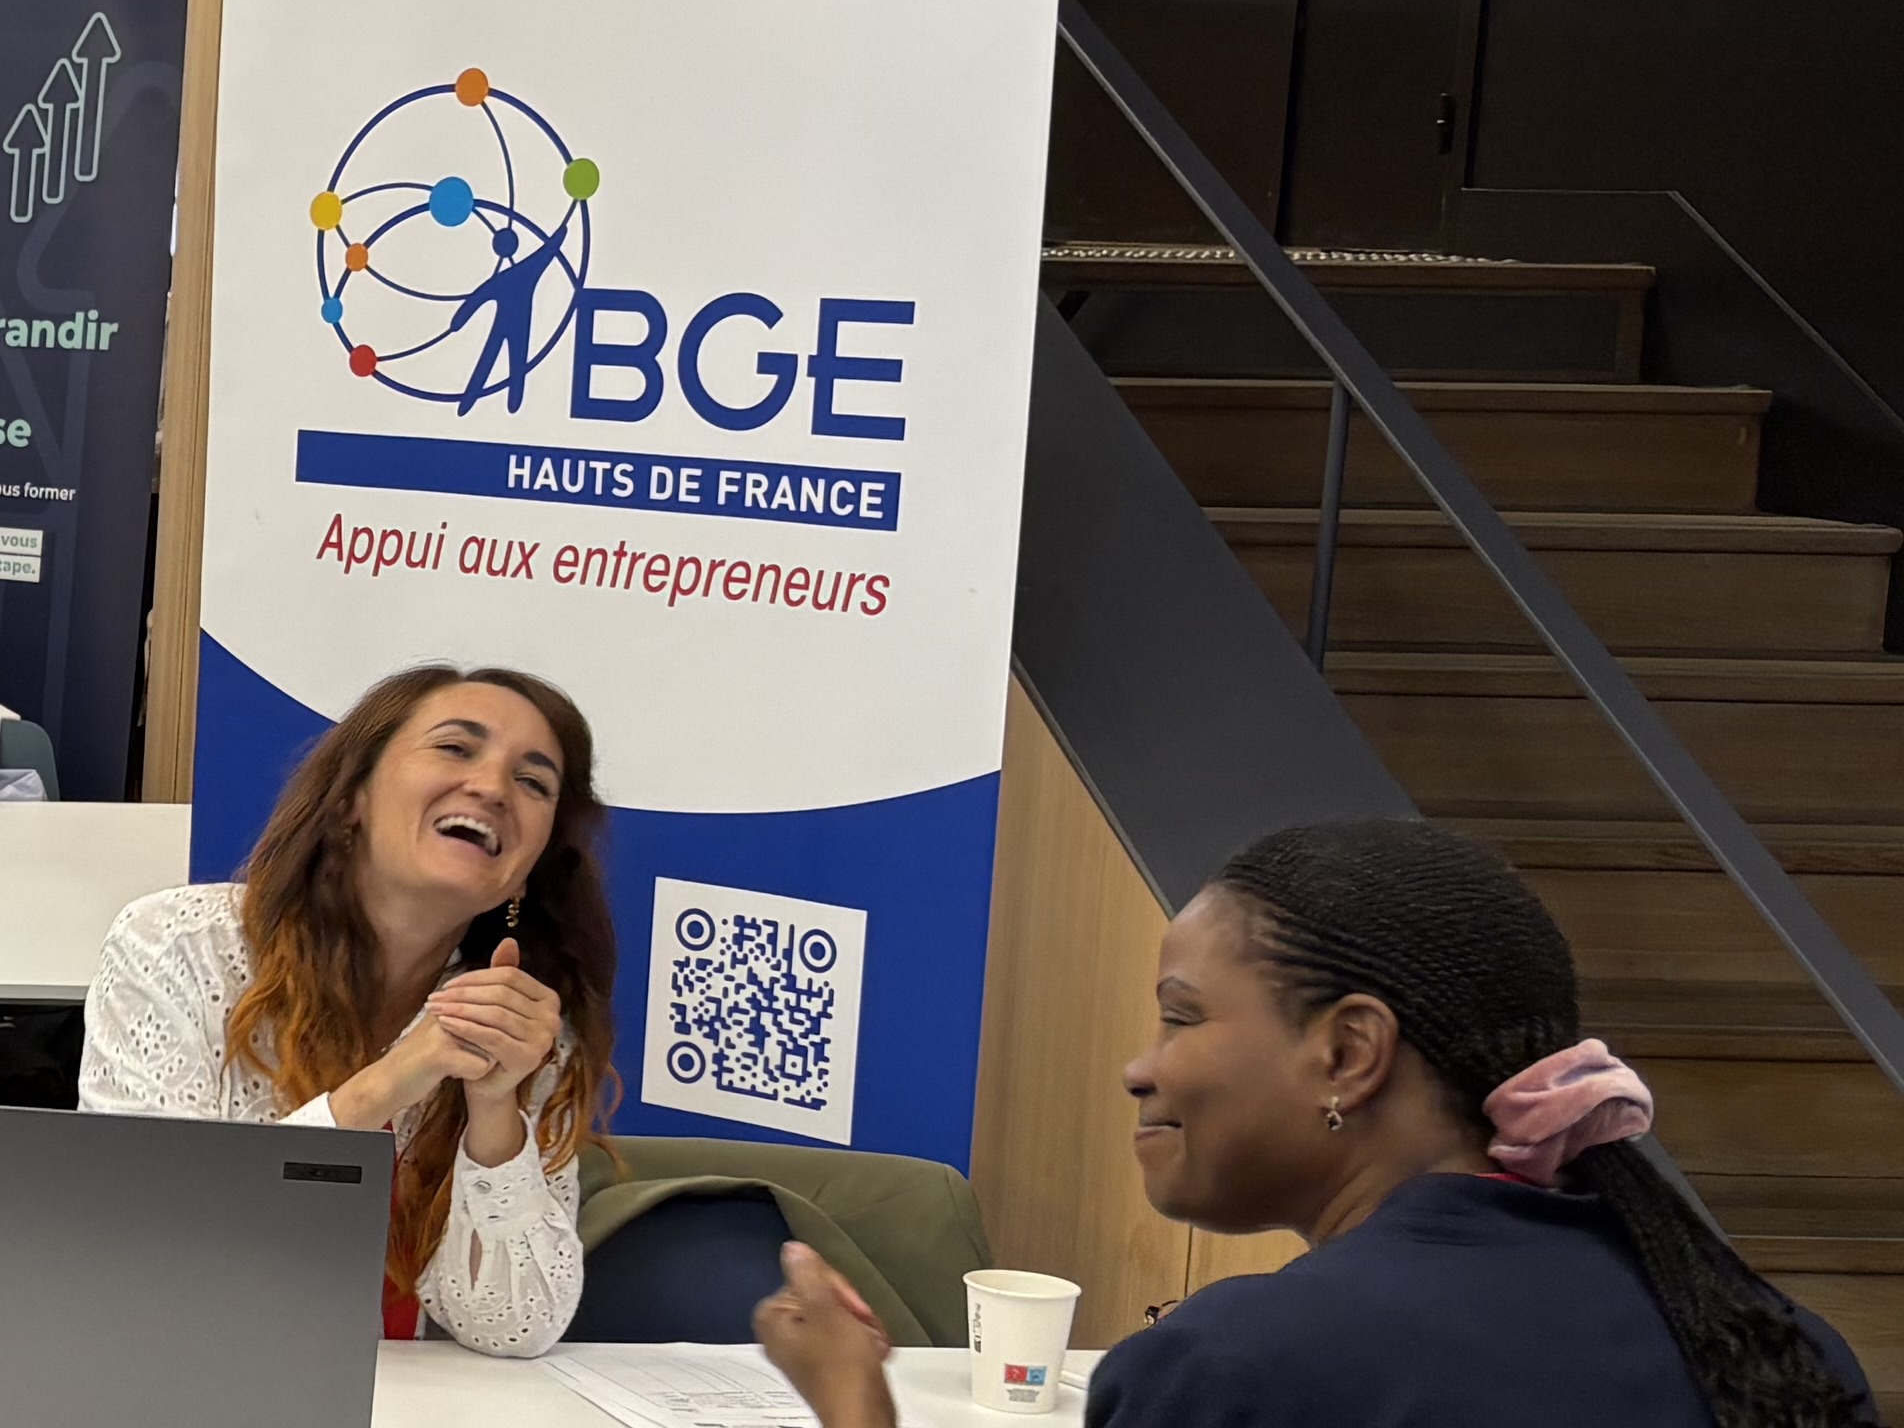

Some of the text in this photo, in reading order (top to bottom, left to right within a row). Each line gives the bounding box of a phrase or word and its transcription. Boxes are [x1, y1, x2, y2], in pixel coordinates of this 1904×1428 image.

[570, 286, 917, 440] BGE
[23, 482, 76, 501] former
[507, 453, 885, 521] HAUTS DE FRANCE
[0, 534, 38, 549] vous
[316, 512, 892, 616] Appui aux entrepreneurs
